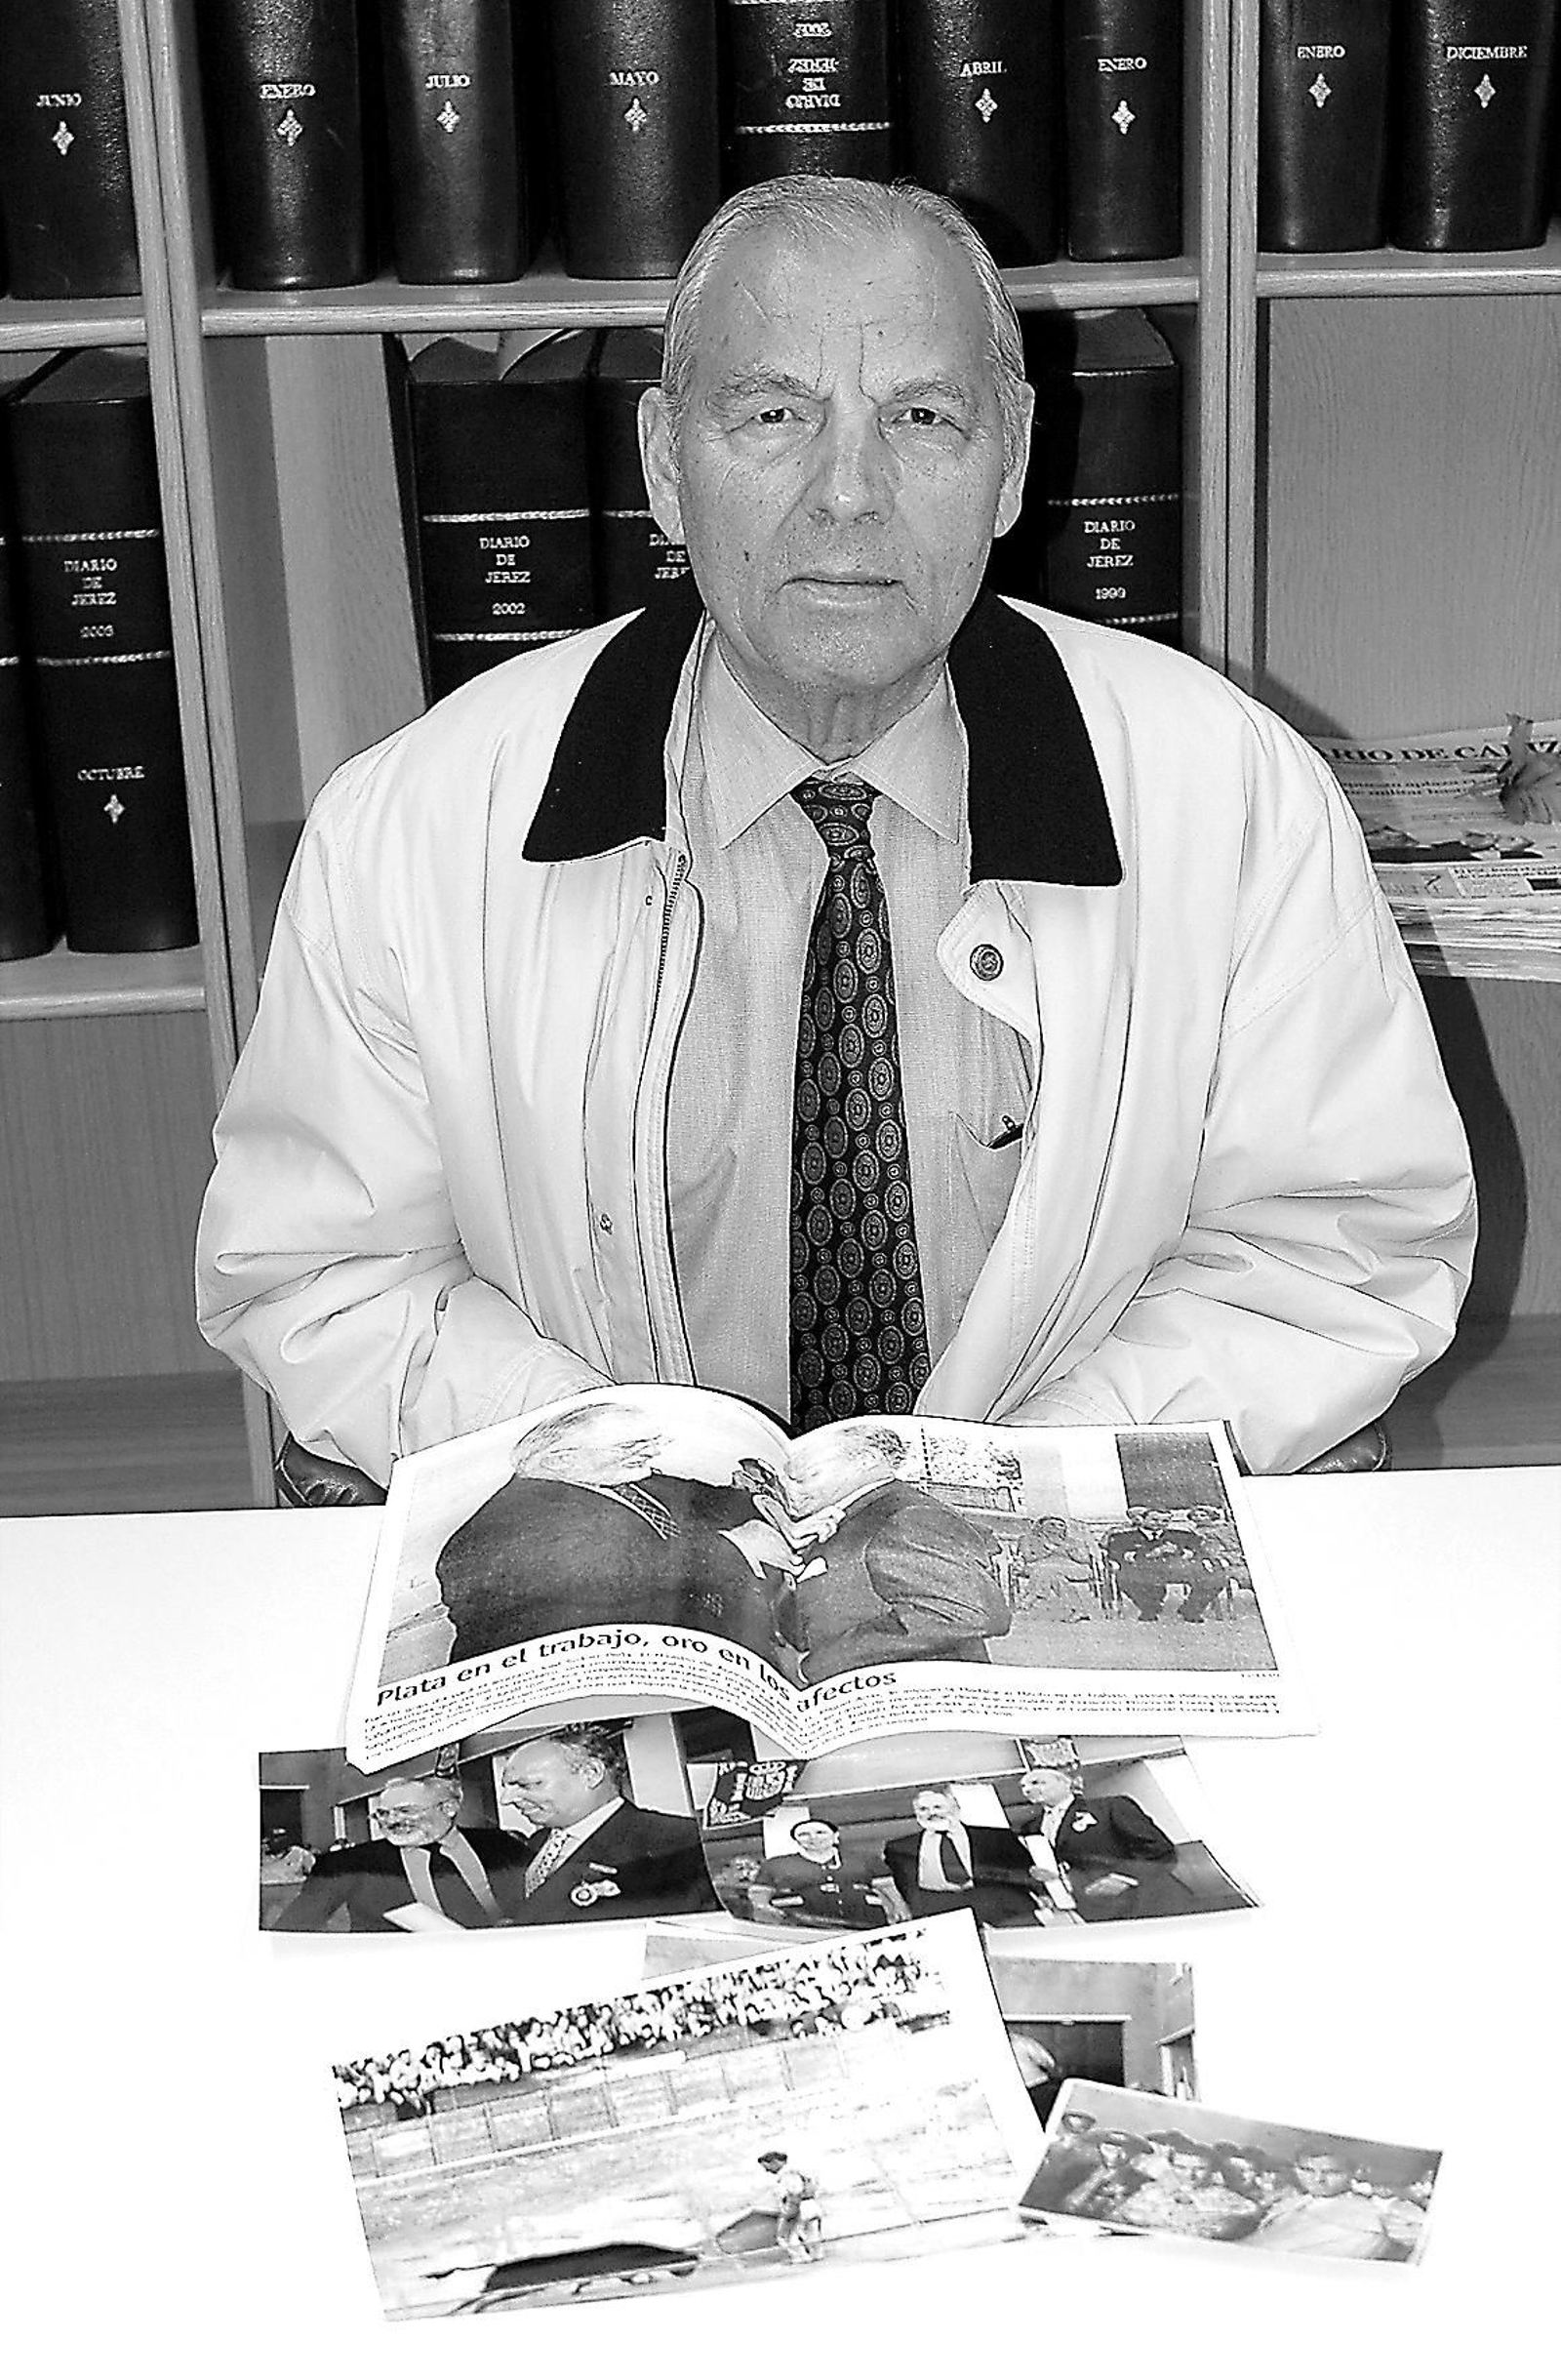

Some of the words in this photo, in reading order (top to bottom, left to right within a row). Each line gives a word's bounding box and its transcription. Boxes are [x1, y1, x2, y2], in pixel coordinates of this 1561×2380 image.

[1297, 45, 1345, 60] ENERO
[1446, 45, 1528, 61] DICIEMBRE
[787, 58, 839, 73] JEREZ
[960, 61, 1008, 76] ABRIL
[1097, 57, 1147, 72] ENERO
[425, 74, 471, 89] JULIO
[610, 71, 660, 86] MAYO
[802, 77, 826, 92] DE
[36, 93, 82, 107] JUNIO
[784, 94, 841, 109] DIARIO
[1084, 519, 1136, 534] DIARIO
[479, 535, 530, 549] DIARIO
[1100, 537, 1121, 550] DE
[63, 558, 118, 572] DIARIO
[496, 553, 516, 566] DE
[1086, 554, 1134, 568] JEREZ
[82, 576, 102, 589] DE
[485, 571, 531, 584] JEREZ
[71, 591, 117, 606] JEREZ
[492, 602, 526, 616] 2002
[1400, 747, 1449, 760] DE
[77, 765, 145, 781] OCTUBRE
[377, 1675, 447, 1707] Plata
[457, 1663, 491, 1682] en
[501, 1647, 528, 1669] el
[539, 1629, 649, 1658] trabajo,
[661, 1634, 708, 1654] oro
[718, 1647, 750, 1671] en
[759, 1663, 790, 1702] los
[796, 1672, 898, 1713] afectos
